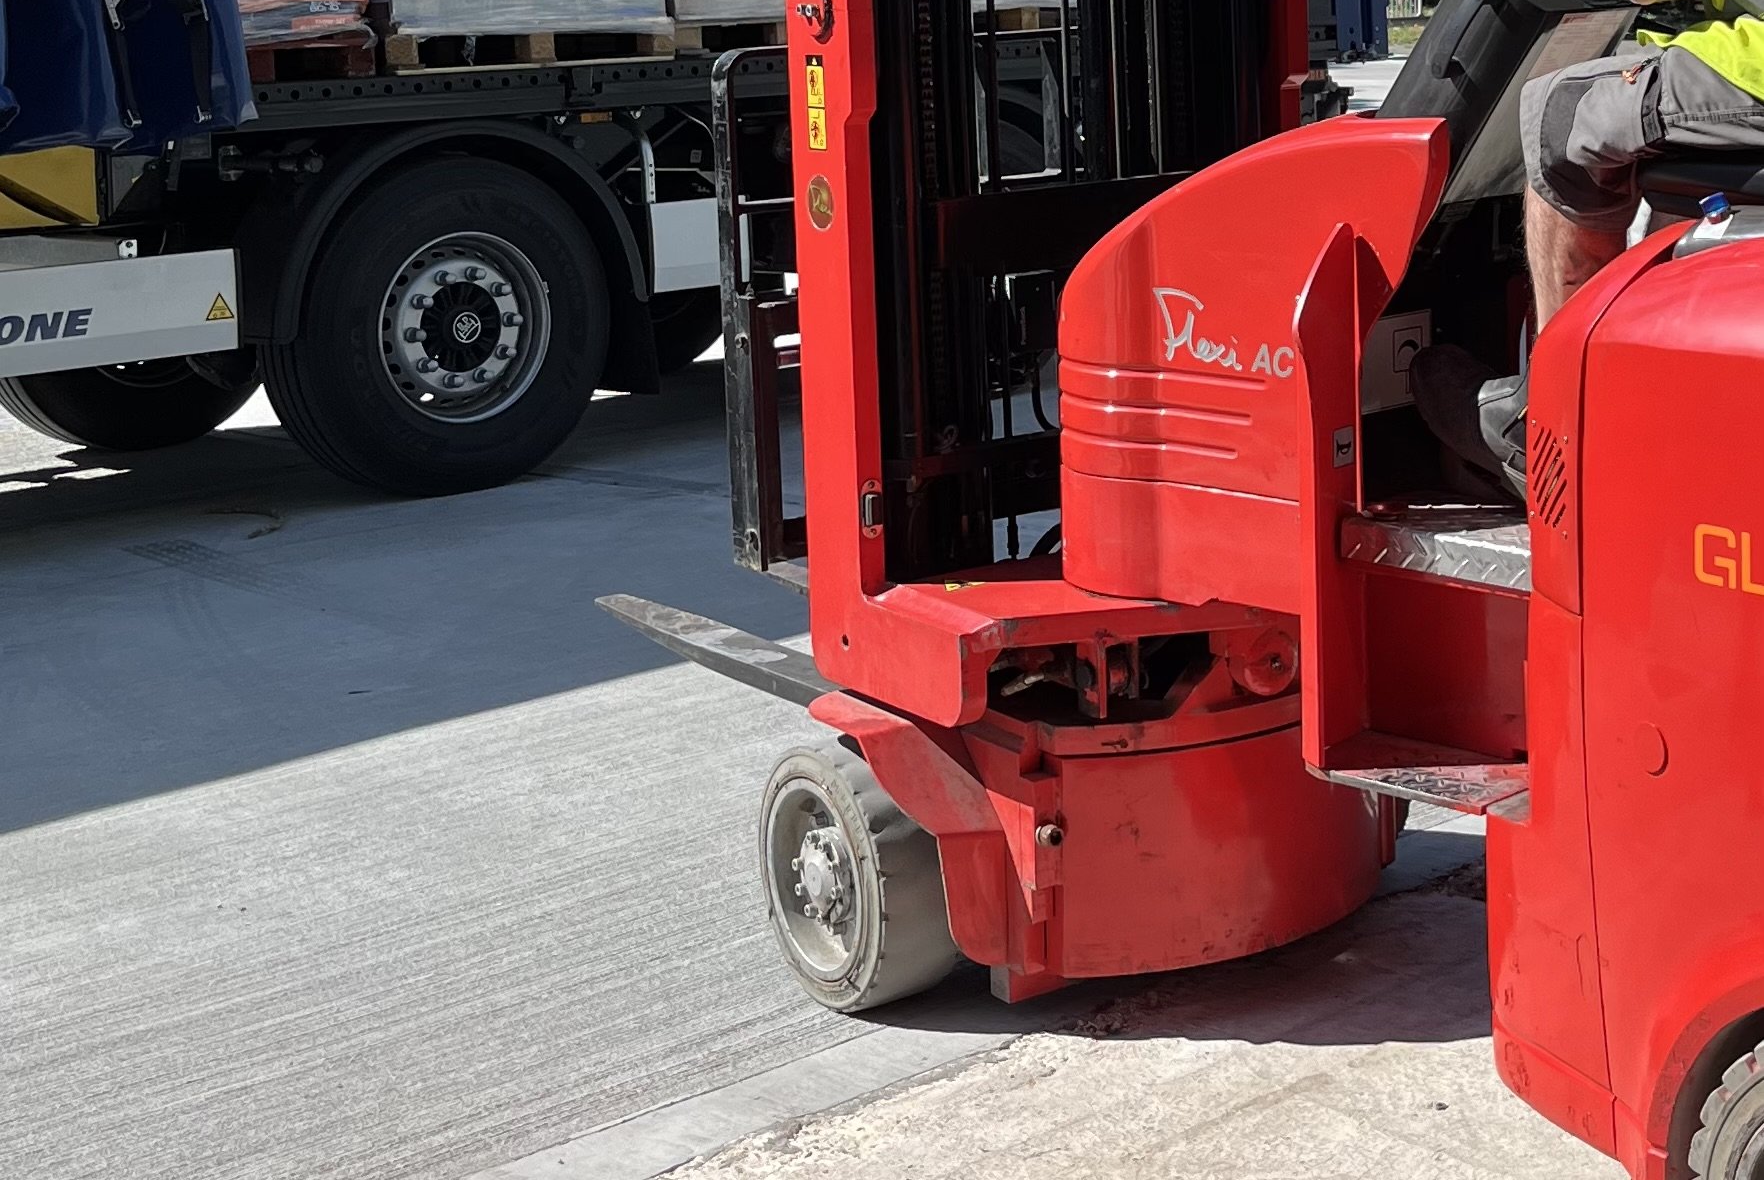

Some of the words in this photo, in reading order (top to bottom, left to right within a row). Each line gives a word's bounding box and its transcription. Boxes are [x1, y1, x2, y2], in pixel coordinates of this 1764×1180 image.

[1152, 287, 1243, 371] Flexi
[1251, 343, 1294, 378] AC
[1694, 523, 1764, 596] GL
